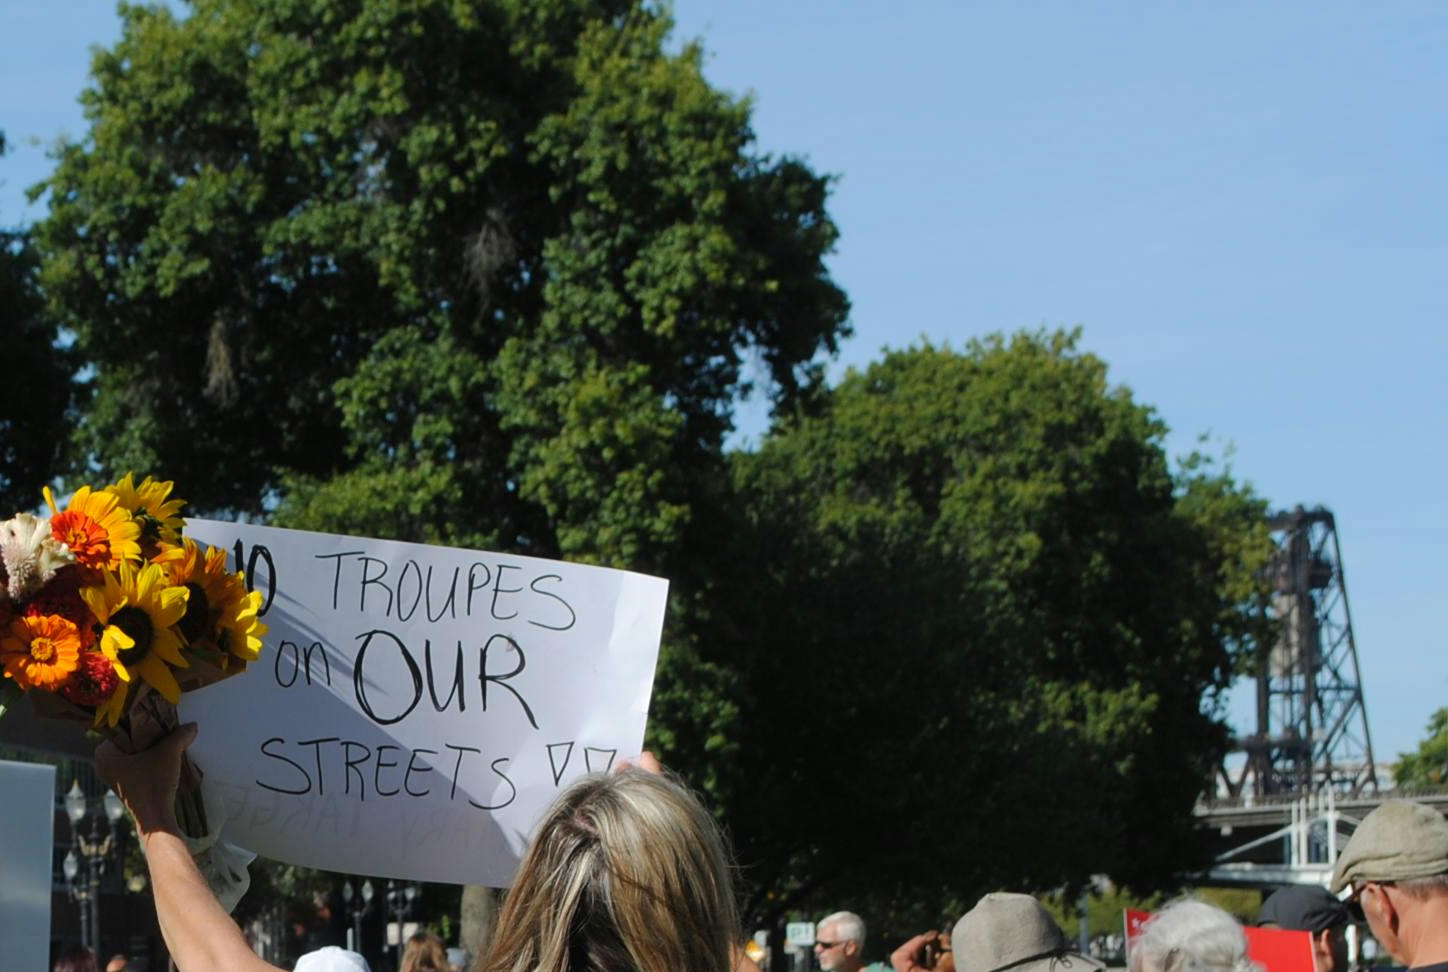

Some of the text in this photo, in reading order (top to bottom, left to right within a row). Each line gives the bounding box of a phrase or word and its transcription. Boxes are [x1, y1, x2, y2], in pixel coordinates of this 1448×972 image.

[314, 550, 577, 632] TROUPES
[274, 629, 539, 730] on OUR
[255, 737, 517, 811] STREETS
